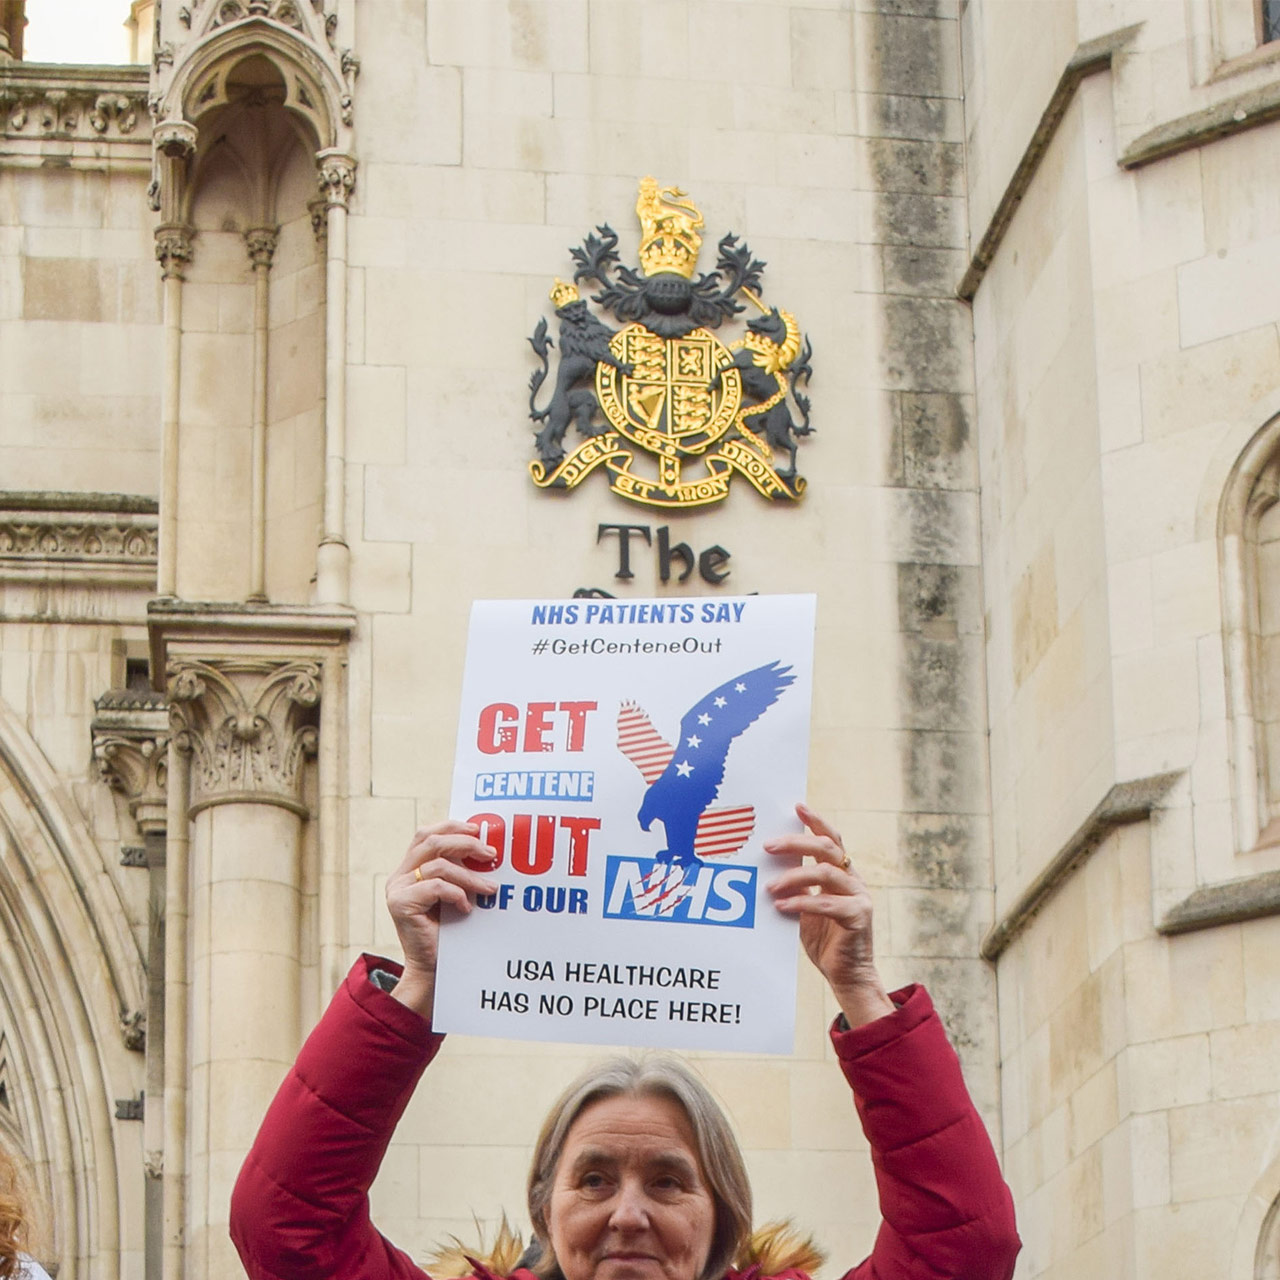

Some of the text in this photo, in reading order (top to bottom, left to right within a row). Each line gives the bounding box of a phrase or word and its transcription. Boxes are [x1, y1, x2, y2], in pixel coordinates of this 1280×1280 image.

[719, 440, 782, 497] DROIT
[596, 522, 732, 584] The
[531, 602, 747, 625] NHS PATIENTS SAY
[531, 637, 723, 656] #GetCenteneOut
[476, 700, 598, 755] GET
[475, 771, 595, 799] CENTENE
[462, 812, 602, 877] OUT
[523, 884, 589, 915] OUR
[606, 860, 754, 924] NHS
[506, 959, 722, 990] USA HEALTHCARE
[480, 990, 742, 1024] HAS NO PLACE HERE!
